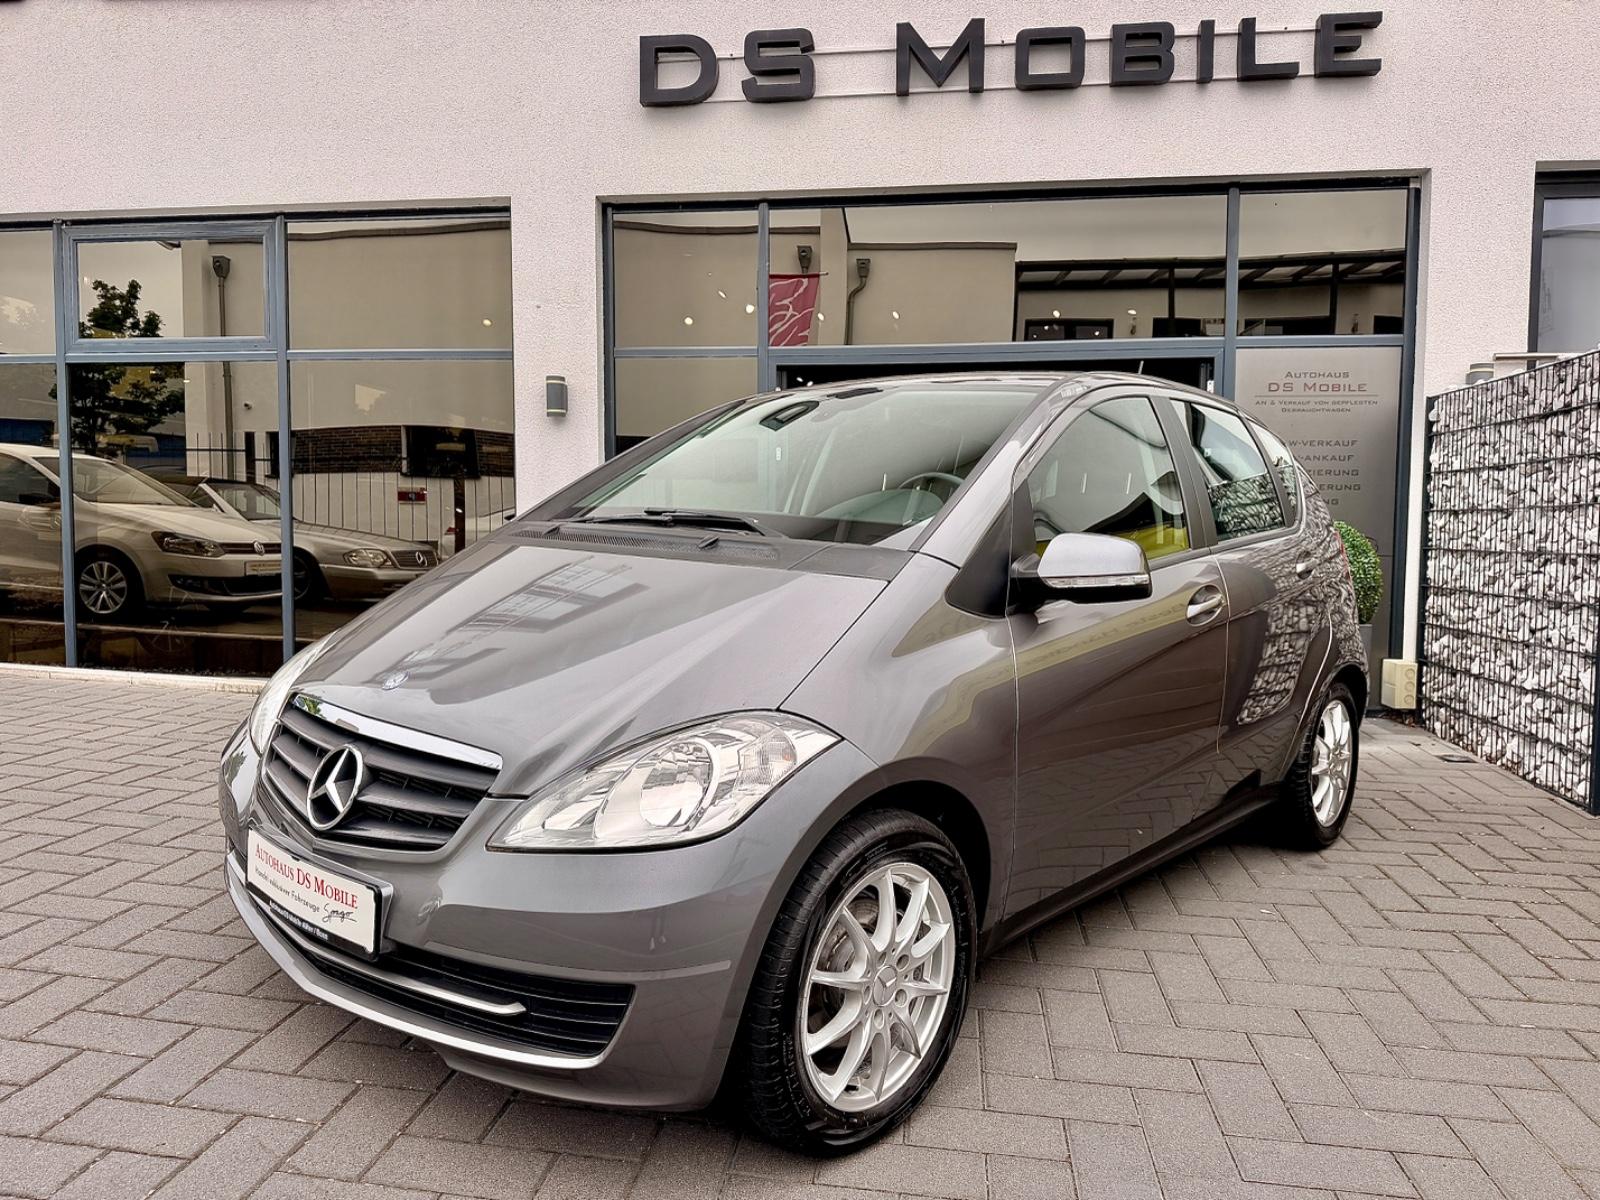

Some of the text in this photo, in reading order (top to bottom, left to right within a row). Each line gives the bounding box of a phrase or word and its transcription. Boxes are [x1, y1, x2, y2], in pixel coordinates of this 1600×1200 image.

[639, 10, 1384, 107] DS MOBILE
[1285, 371, 1350, 379] AUTOHAUS
[1268, 382, 1368, 392] DS MOBILE
[1288, 439, 1359, 447] W-VERKAUF
[255, 843, 359, 910] AUTOHAUS DS MOBILE
